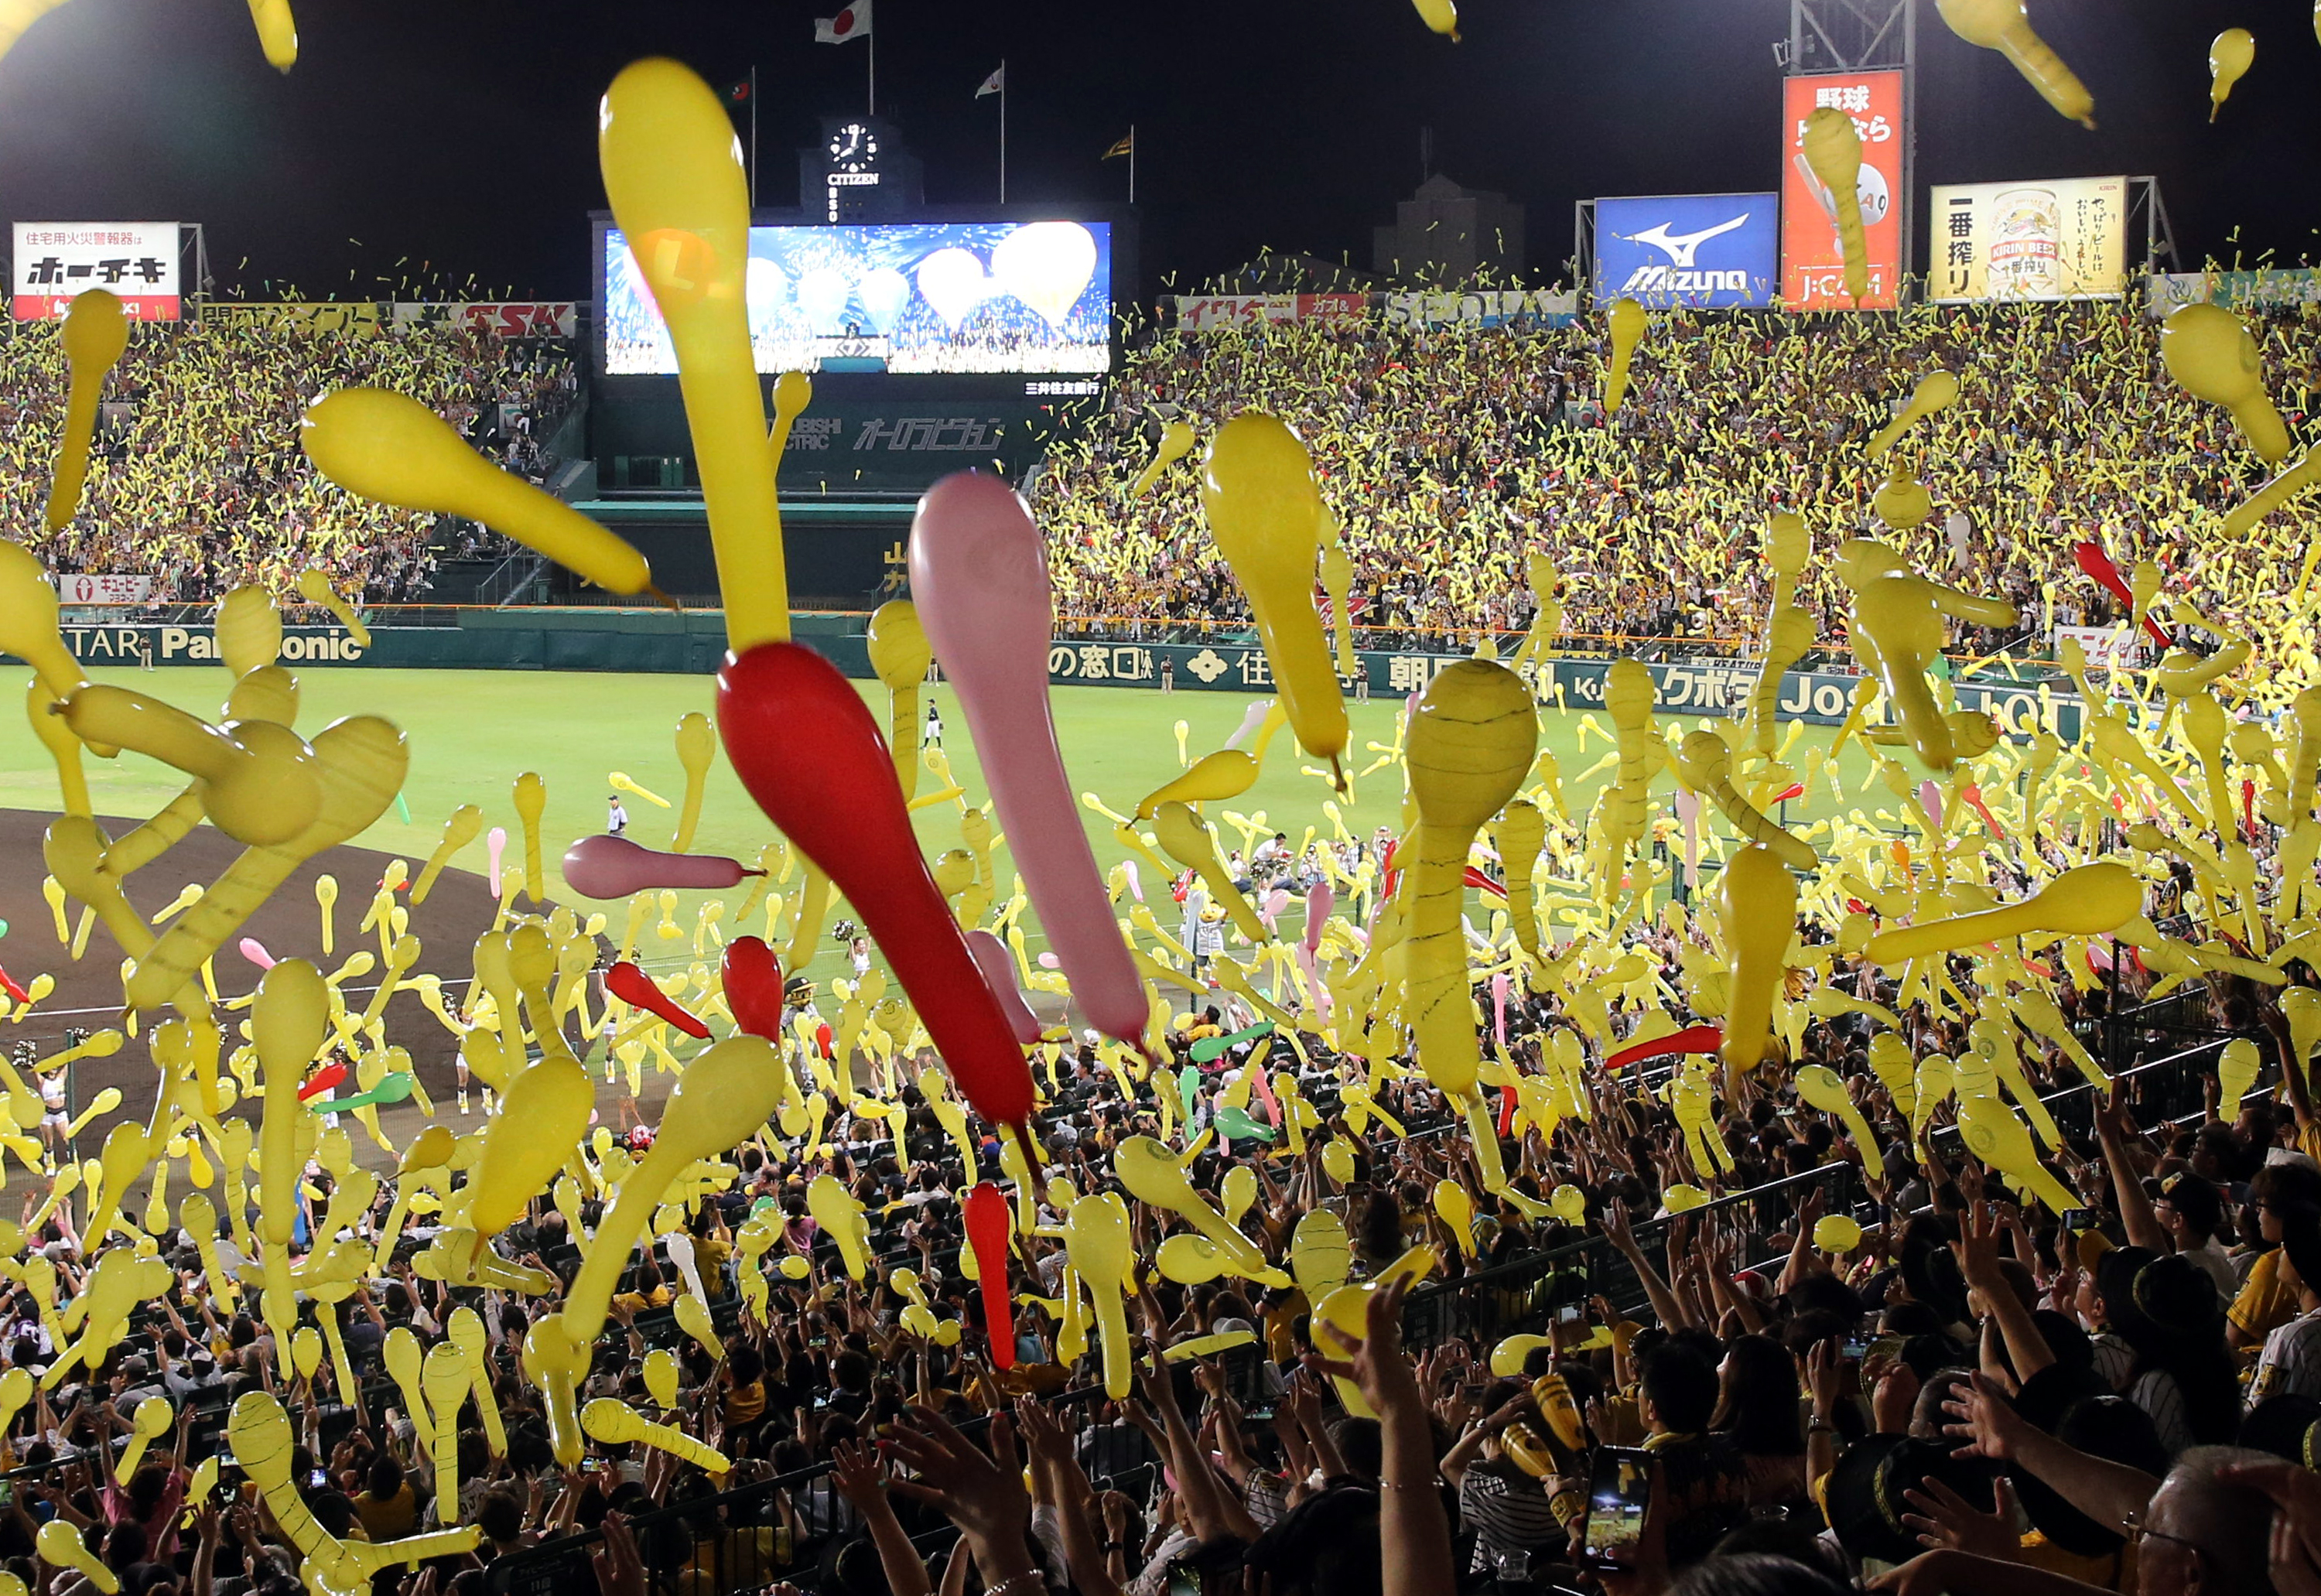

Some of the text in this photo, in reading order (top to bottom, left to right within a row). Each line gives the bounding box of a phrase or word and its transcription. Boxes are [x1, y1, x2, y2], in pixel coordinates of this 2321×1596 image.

[1816, 85, 1870, 112] 野球
[827, 173, 880, 186] CITIZEN
[26, 231, 142, 246] 住宅用火災警報器は
[1948, 198, 1974, 295] 一番搾り
[1993, 241, 2056, 258] KIRIN BEER
[27, 257, 166, 284] ホーチキ
[466, 305, 569, 336] SSK
[101, 577, 141, 593] キューピー
[59, 628, 142, 658] TAR
[161, 627, 363, 661] Paonic
